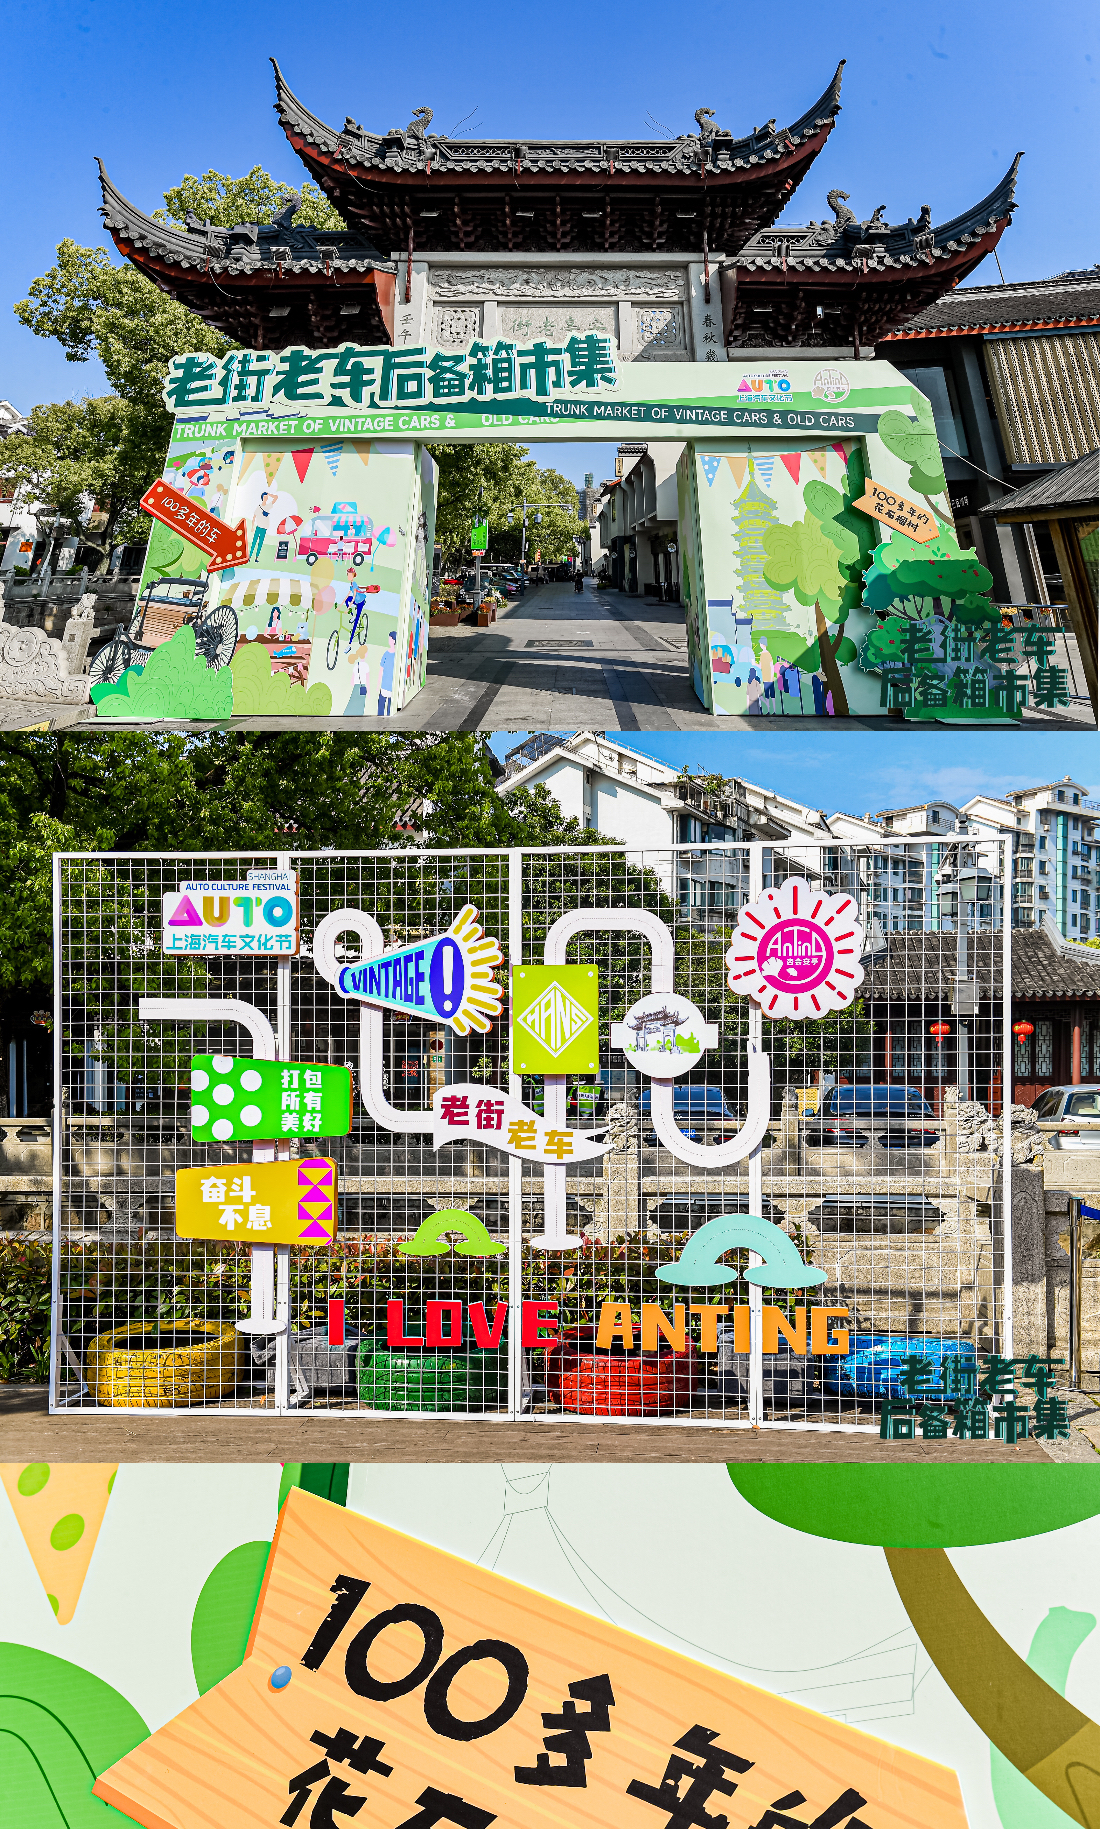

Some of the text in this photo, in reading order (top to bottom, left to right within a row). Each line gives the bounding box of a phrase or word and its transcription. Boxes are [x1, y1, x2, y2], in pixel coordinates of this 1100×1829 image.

[167, 333, 617, 409] 老街老车后备箱市集
[737, 379, 791, 392] AUTO
[176, 423, 227, 438] TRUNK
[233, 420, 298, 436] MARKET
[303, 418, 324, 433] OF
[329, 416, 394, 432] VINTAGE
[399, 414, 442, 430] CARS
[445, 413, 456, 428] &
[482, 414, 512, 426] OLD
[546, 403, 854, 428] TRUNK MARKET OF VINTAGE CARS & OLD CARS
[872, 487, 930, 525] 100多年的
[875, 502, 919, 532] 花石榴树
[161, 496, 221, 543] 100多年的车
[186, 883, 291, 891] AUTO CULTURE FESTIVAL
[168, 894, 293, 928] AUTO
[166, 933, 292, 951] 上海汽车文化节
[281, 1069, 322, 1088] 打包
[281, 1091, 322, 1111] 所有
[440, 1095, 504, 1130] 老街
[281, 1112, 322, 1132] 美好
[507, 1119, 574, 1160] 老车
[200, 1176, 256, 1203] 奋斗
[219, 1204, 272, 1230] 不息
[328, 1299, 849, 1355] I LOVE ANTING
